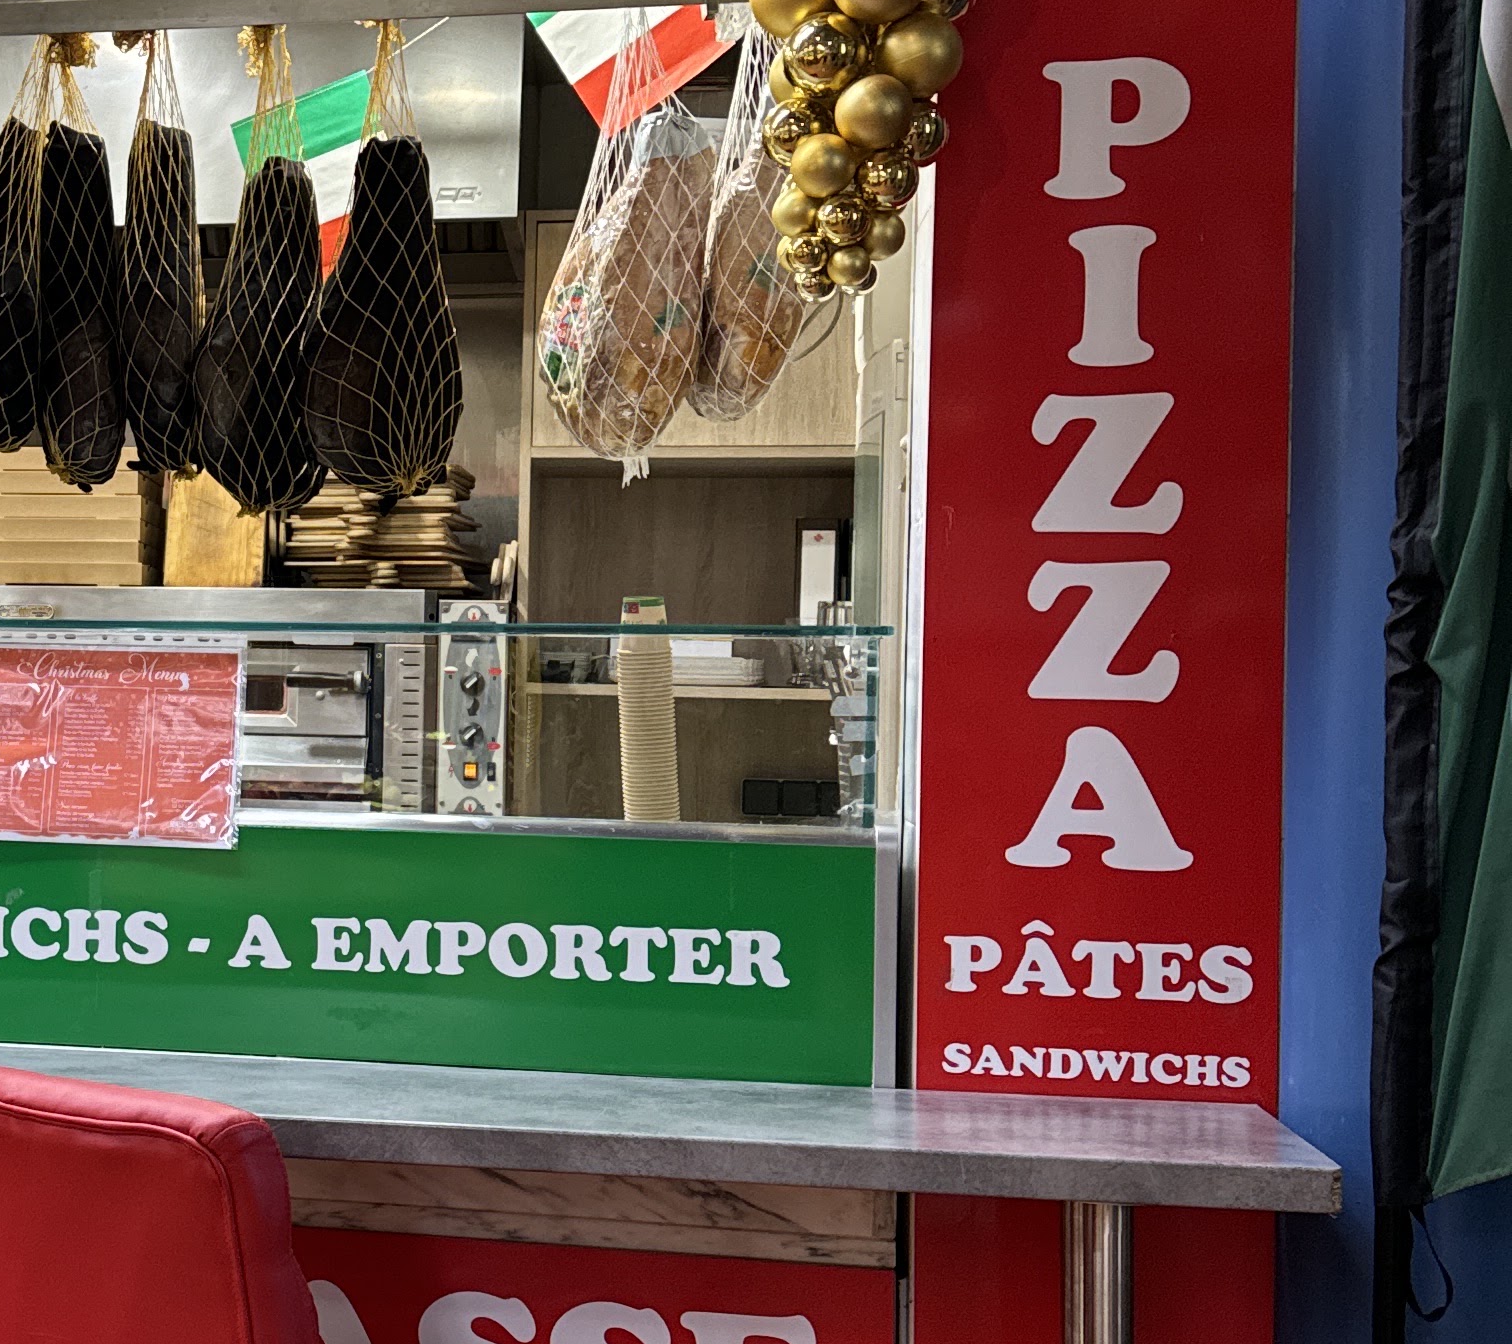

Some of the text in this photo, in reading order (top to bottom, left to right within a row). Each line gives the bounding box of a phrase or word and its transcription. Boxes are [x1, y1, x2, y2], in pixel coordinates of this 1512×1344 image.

[1004, 56, 1194, 872] PIZZA
[16, 651, 110, 681] Christmas
[227, 914, 292, 970] A
[311, 917, 791, 988] EMPORTER
[943, 919, 1254, 1005] PÂTES
[941, 1042, 1251, 1089] SANDWICHS
